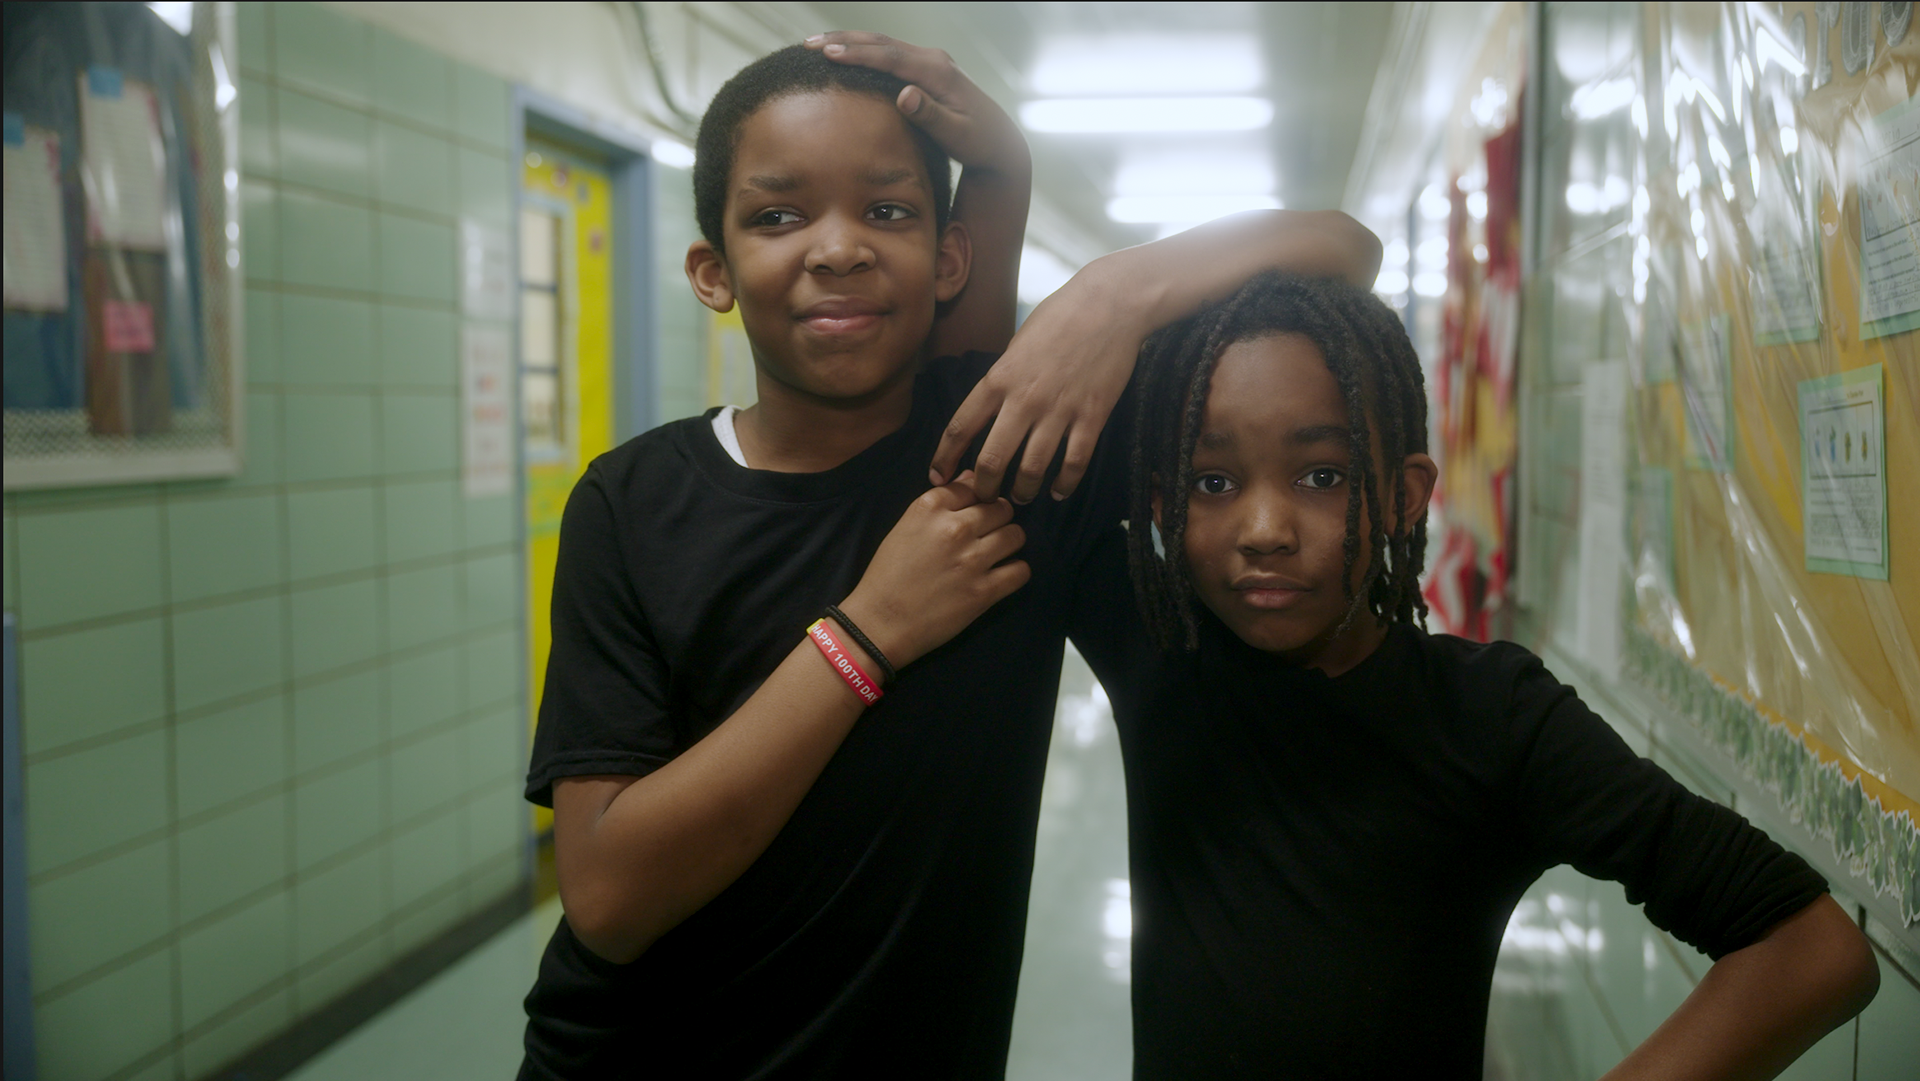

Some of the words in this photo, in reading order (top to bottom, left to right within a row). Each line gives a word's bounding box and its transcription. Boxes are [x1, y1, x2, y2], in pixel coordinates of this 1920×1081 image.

[811, 624, 838, 653] HAPPY
[834, 653, 864, 687] 100TH
[860, 685, 879, 702] DAY
